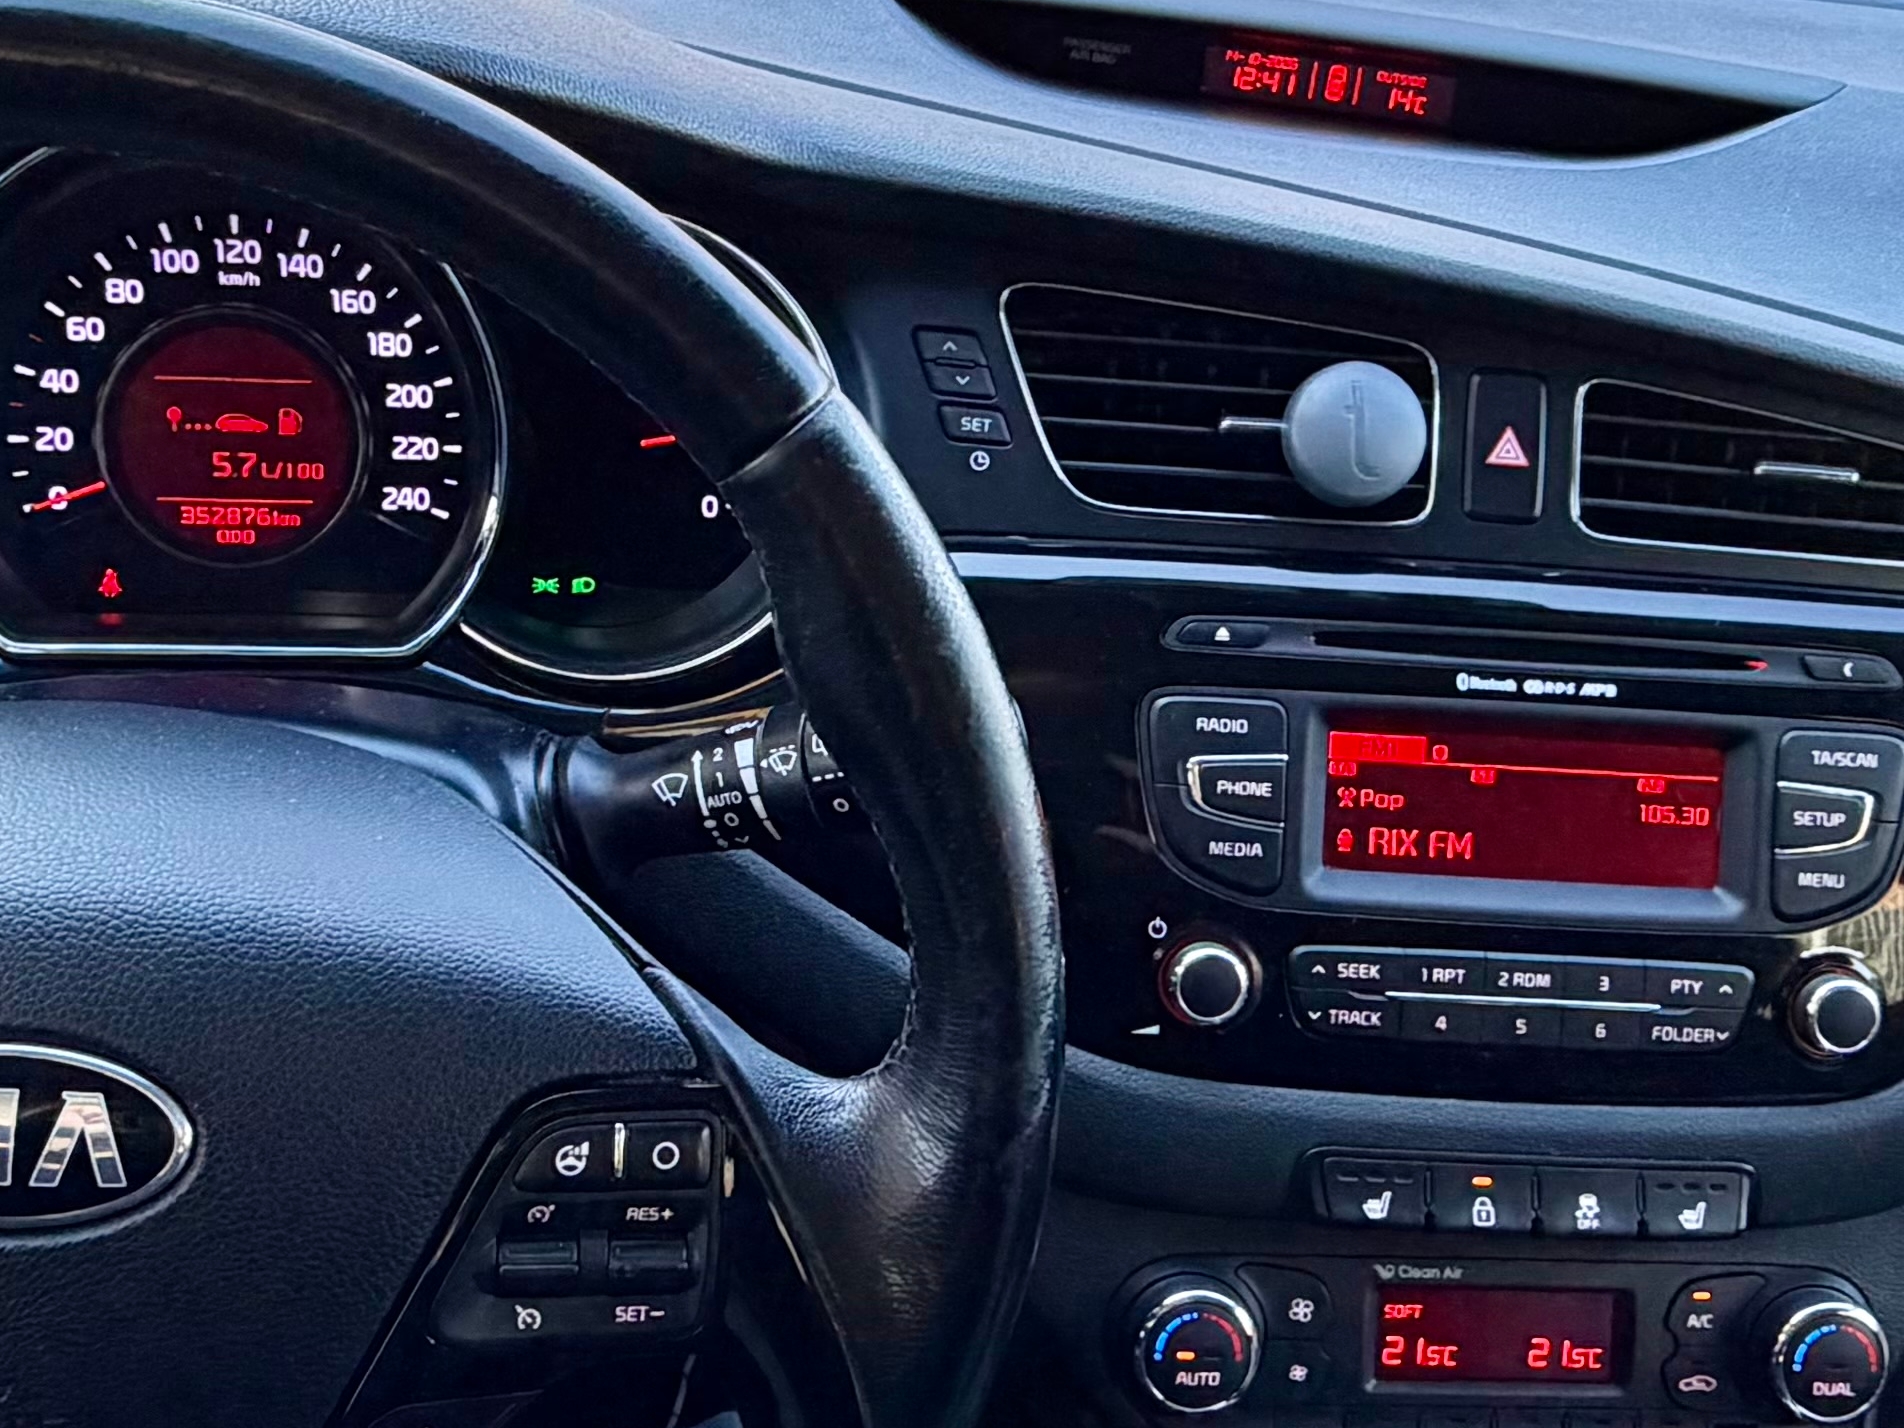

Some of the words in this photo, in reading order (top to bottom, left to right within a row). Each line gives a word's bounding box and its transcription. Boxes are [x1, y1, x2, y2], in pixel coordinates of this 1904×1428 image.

[1233, 66, 1296, 96] 12:41
[213, 239, 262, 264] 120
[149, 249, 199, 274] 100
[277, 253, 324, 278] 140
[218, 271, 261, 289] km/h
[104, 279, 144, 304] 80
[330, 289, 377, 315] 160
[65, 316, 105, 342] 60
[367, 332, 412, 357] 180
[39, 369, 80, 393] 40
[385, 384, 434, 408] 200
[960, 416, 992, 433] SET
[34, 428, 74, 452] 20
[391, 437, 439, 461] 220
[212, 451, 257, 478] 5.7
[381, 486, 432, 511] 240
[701, 494, 719, 518] 0
[1196, 716, 1249, 734] RADIO
[712, 747, 724, 762] 2
[1811, 750, 1879, 768] TA/SCAN
[1216, 779, 1273, 798] PHONE
[707, 791, 743, 809] AUTO
[1360, 788, 1406, 811] Pop
[1638, 803, 1710, 827] 105.30
[1793, 810, 1847, 828] SETUP
[1208, 841, 1264, 859] MEDIA
[1367, 826, 1418, 858] RIX
[1428, 830, 1474, 861] FM
[1798, 872, 1846, 890] MENU
[1336, 962, 1381, 980] SEEK
[1420, 967, 1428, 983] 1
[1431, 967, 1466, 985] RPT
[1498, 971, 1509, 987] 2
[1511, 972, 1552, 989] RDM
[1598, 976, 1610, 993] 3
[1670, 978, 1704, 996] PTY
[1328, 1009, 1382, 1028] TRACK
[1434, 1015, 1448, 1032] 4
[1515, 1019, 1527, 1035] 5
[1594, 1022, 1607, 1039] 6
[1651, 1025, 1715, 1043] FOLDER
[1398, 1265, 1440, 1280] Clean
[1442, 1266, 1464, 1280] Air
[1383, 1304, 1424, 1319] SOFT
[1686, 1314, 1714, 1329] A/C
[1175, 1371, 1221, 1387] AUTO
[1812, 1381, 1856, 1398] DUAL
